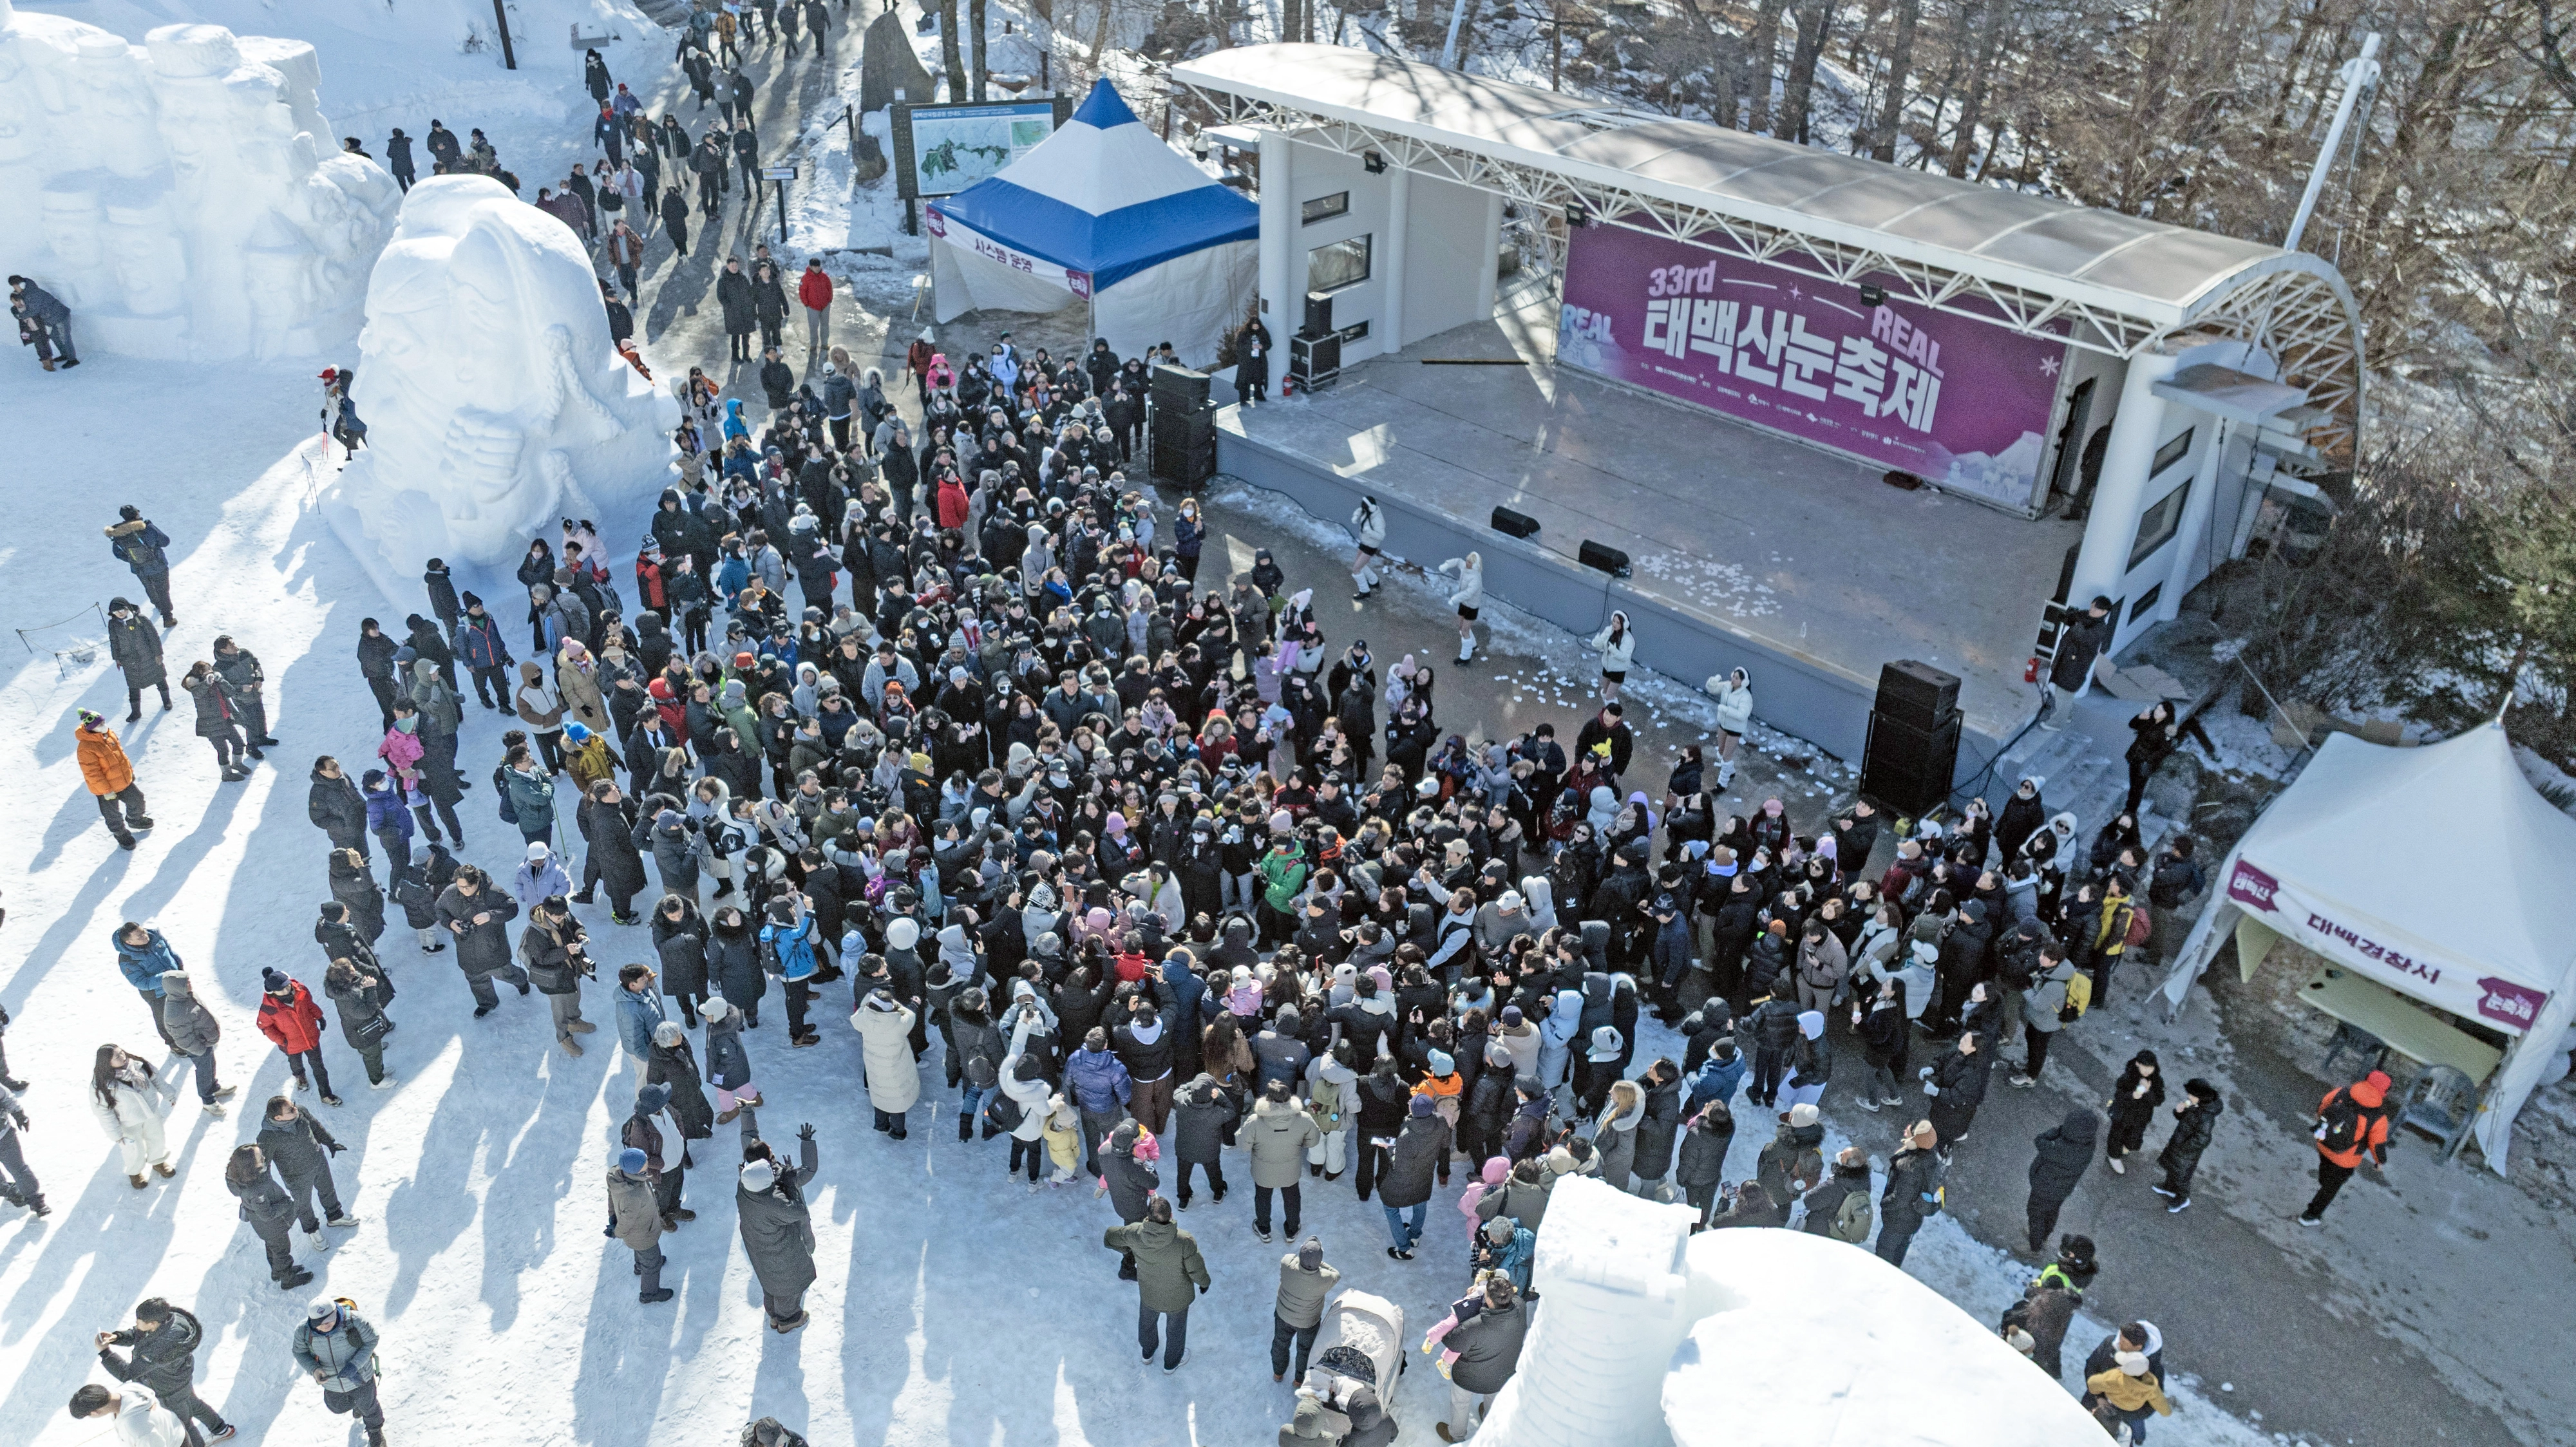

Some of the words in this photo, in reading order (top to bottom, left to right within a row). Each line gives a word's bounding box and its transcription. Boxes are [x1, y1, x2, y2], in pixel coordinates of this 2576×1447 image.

[975, 238, 1007, 264] 시스템
[1009, 253, 1032, 273] 운영
[1648, 260, 1717, 297] 33rd
[1560, 303, 1616, 345] REAL
[1870, 304, 1945, 381] REAL
[1643, 298, 1942, 434] 태백산눈축제
[2233, 878, 2270, 902] 태백산
[2485, 991, 2533, 1021] 눈축제
